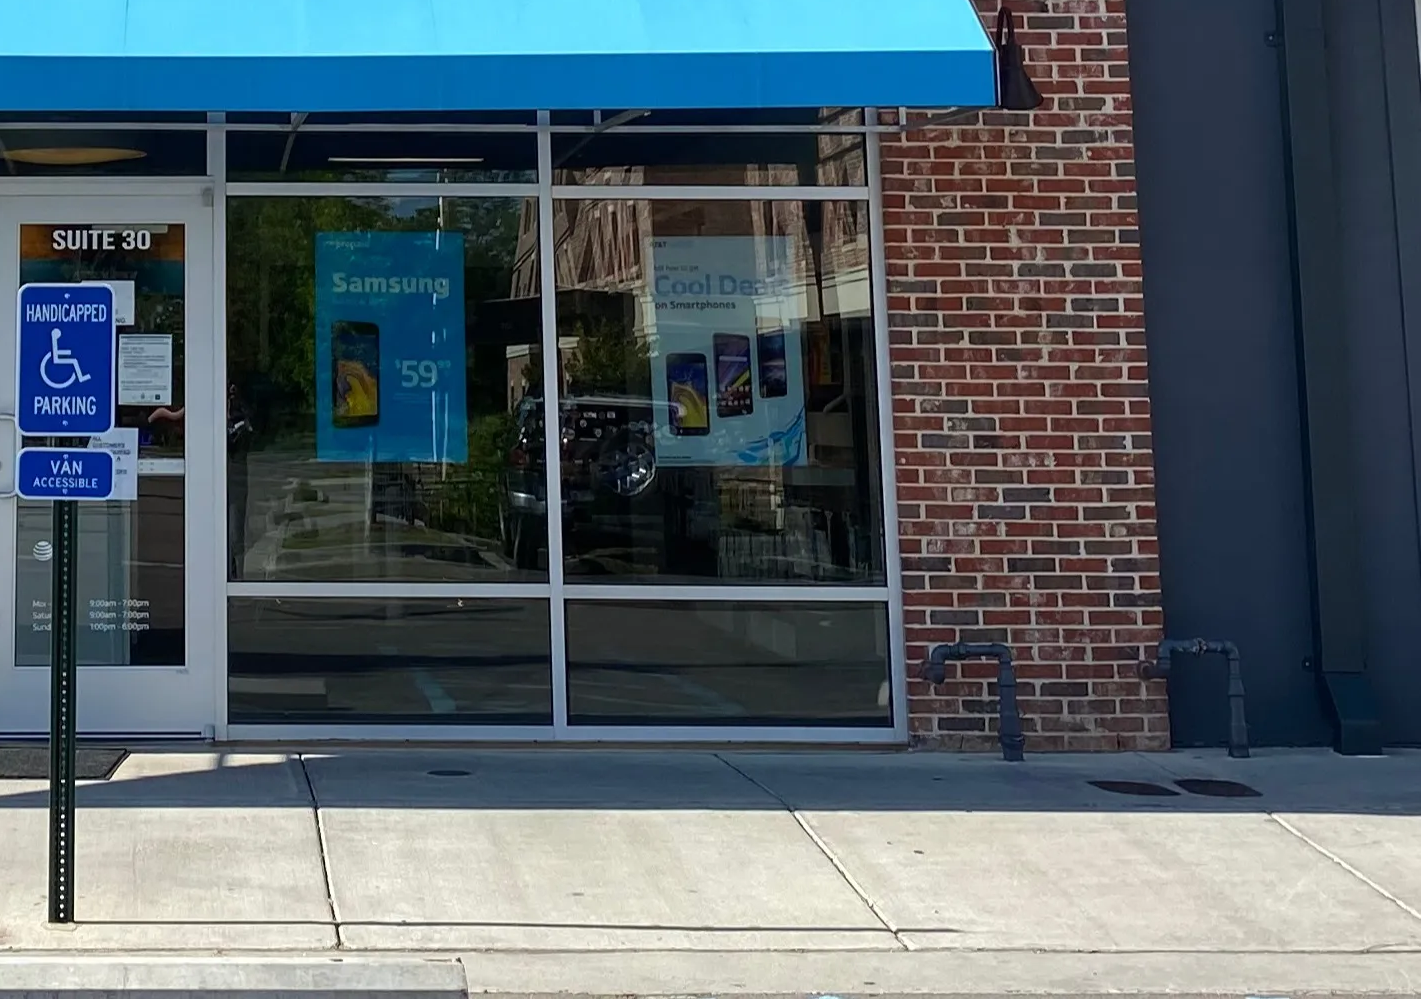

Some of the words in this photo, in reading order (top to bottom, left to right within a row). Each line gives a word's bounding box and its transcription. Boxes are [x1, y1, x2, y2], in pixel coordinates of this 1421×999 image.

[52, 230, 115, 251] SUITE
[122, 230, 151, 251] 30
[332, 272, 449, 299] Samsung
[654, 274, 711, 297] Cool
[718, 274, 789, 297] Dea
[26, 304, 107, 322] HANDICAPPED
[670, 300, 736, 311] Smartphones
[33, 396, 97, 415] PARKING
[50, 460, 82, 475] VAN
[33, 477, 98, 489] ACCESSIBLE
[89, 599, 117, 608] 9:00am
[122, 599, 149, 608] 7:00pm
[122, 611, 149, 619] 7:00pm
